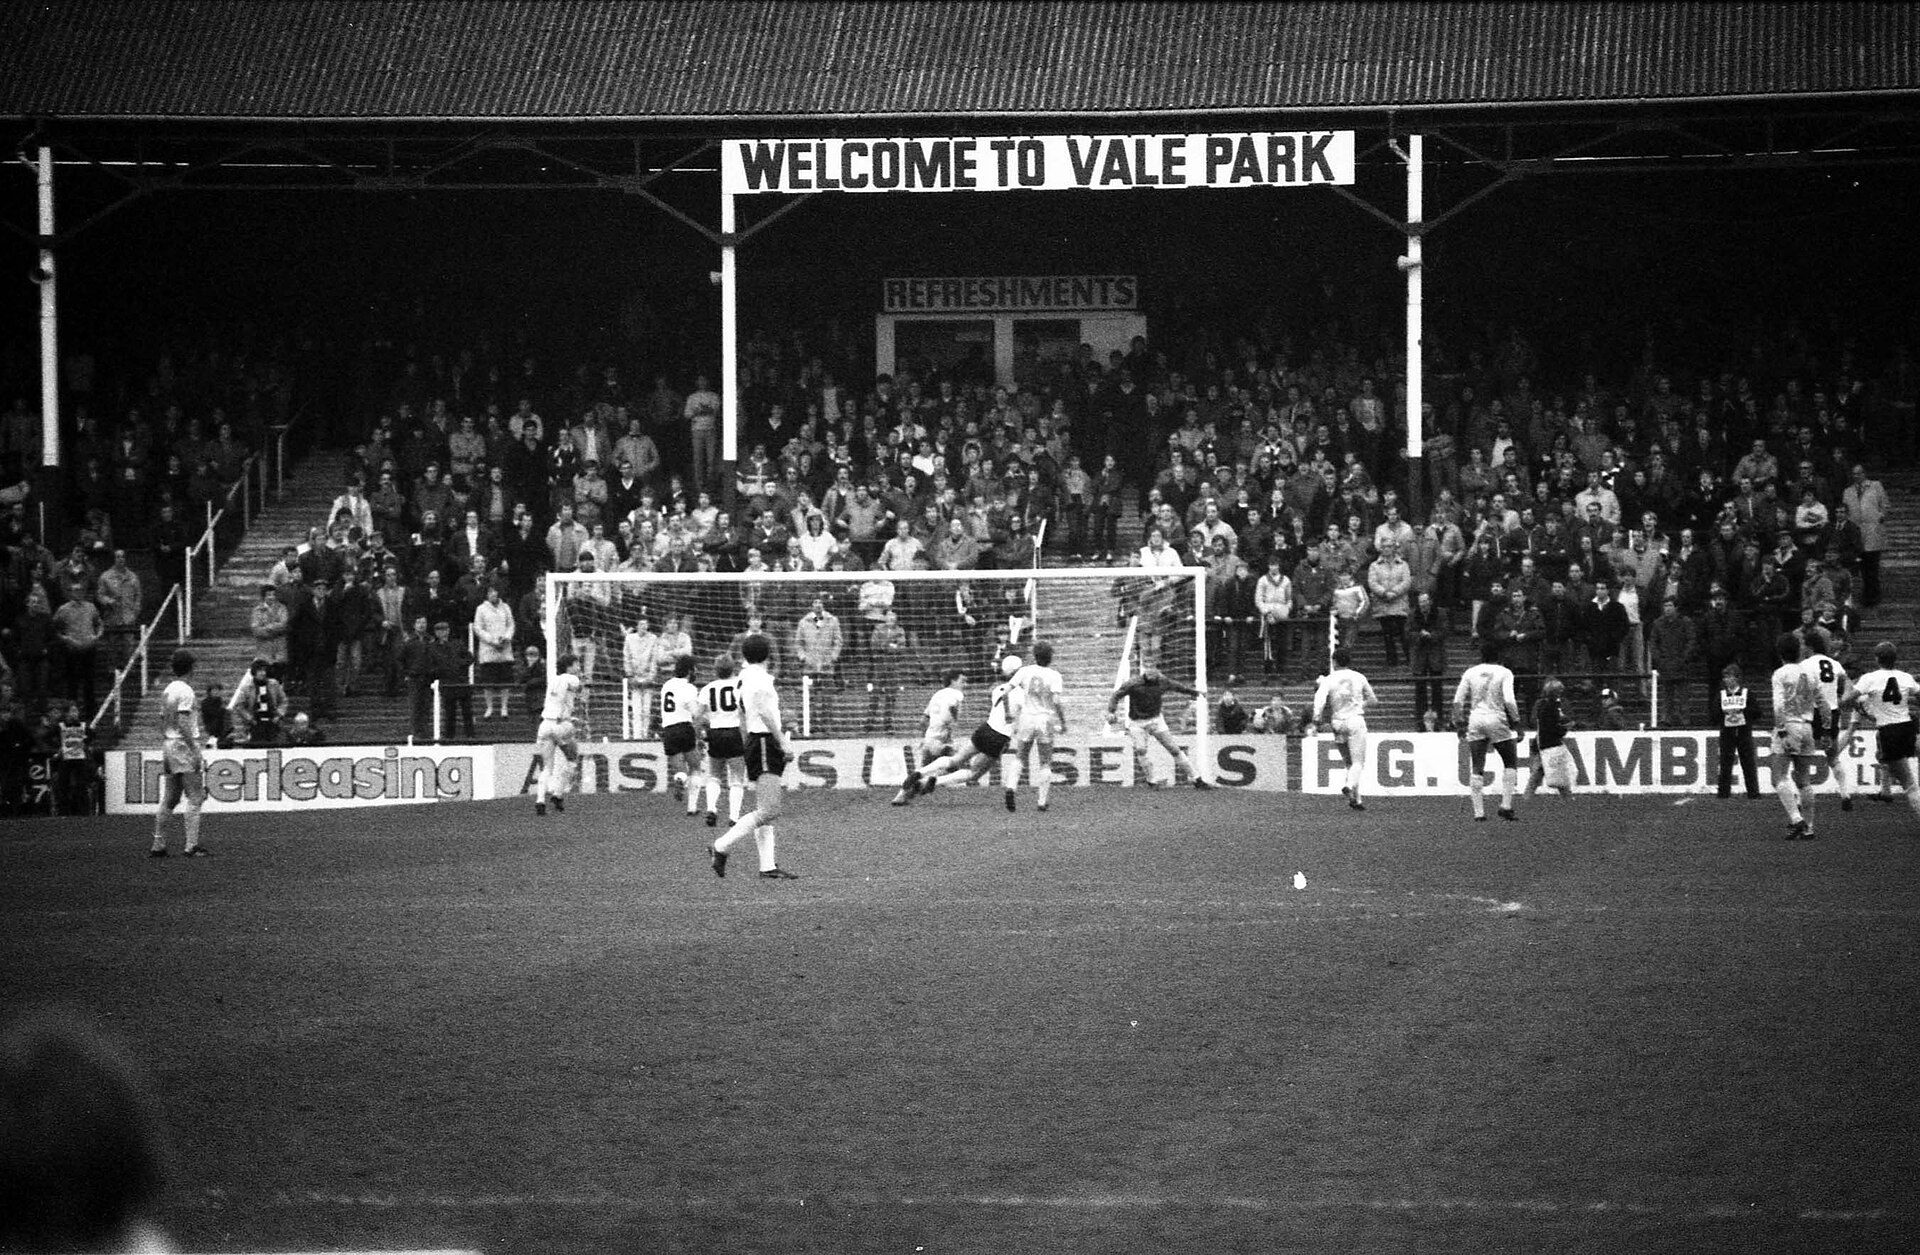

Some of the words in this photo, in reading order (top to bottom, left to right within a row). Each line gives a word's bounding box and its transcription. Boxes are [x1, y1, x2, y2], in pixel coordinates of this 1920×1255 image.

[740, 139, 977, 190] WELCOME
[991, 140, 1045, 187] TO
[1067, 138, 1187, 186] VALE
[1206, 135, 1336, 183] PARK
[887, 277, 1134, 308] REFRESHMENTS
[1819, 659, 1835, 683] 8
[663, 691, 677, 713] 6
[710, 686, 738, 712] 10
[1882, 677, 1902, 705] 4
[125, 747, 473, 804] Inerleasing
